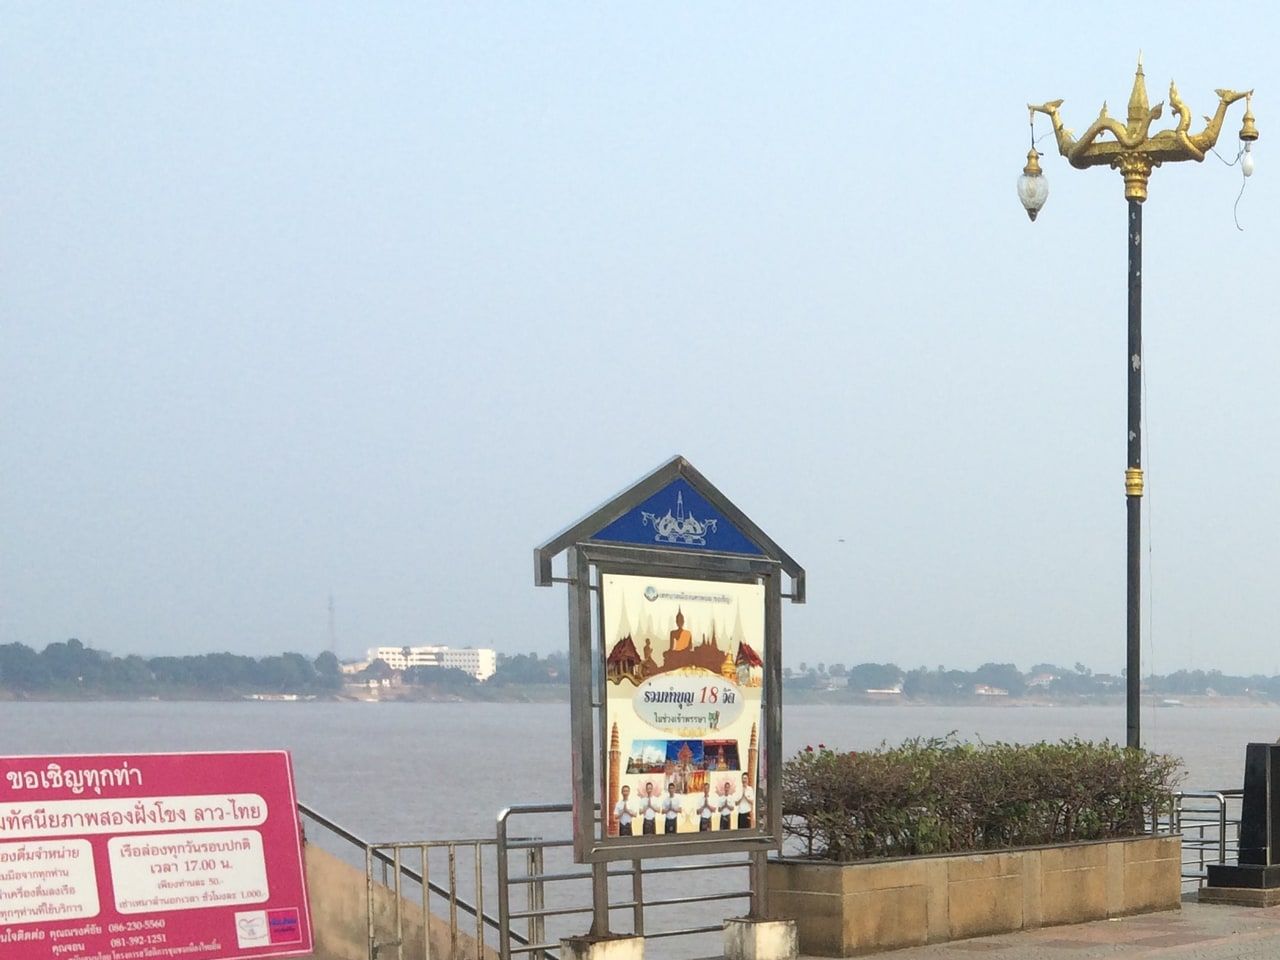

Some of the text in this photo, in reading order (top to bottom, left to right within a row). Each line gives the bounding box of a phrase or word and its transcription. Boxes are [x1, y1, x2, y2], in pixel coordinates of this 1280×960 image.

[643, 682, 735, 709] ร่วมทำบุญ 18 วัด
[6, 761, 143, 795] ขอเชิญทุกท่า
[194, 798, 261, 821] ลาว-ไทย
[150, 859, 233, 874] เวลา 17.00 น.
